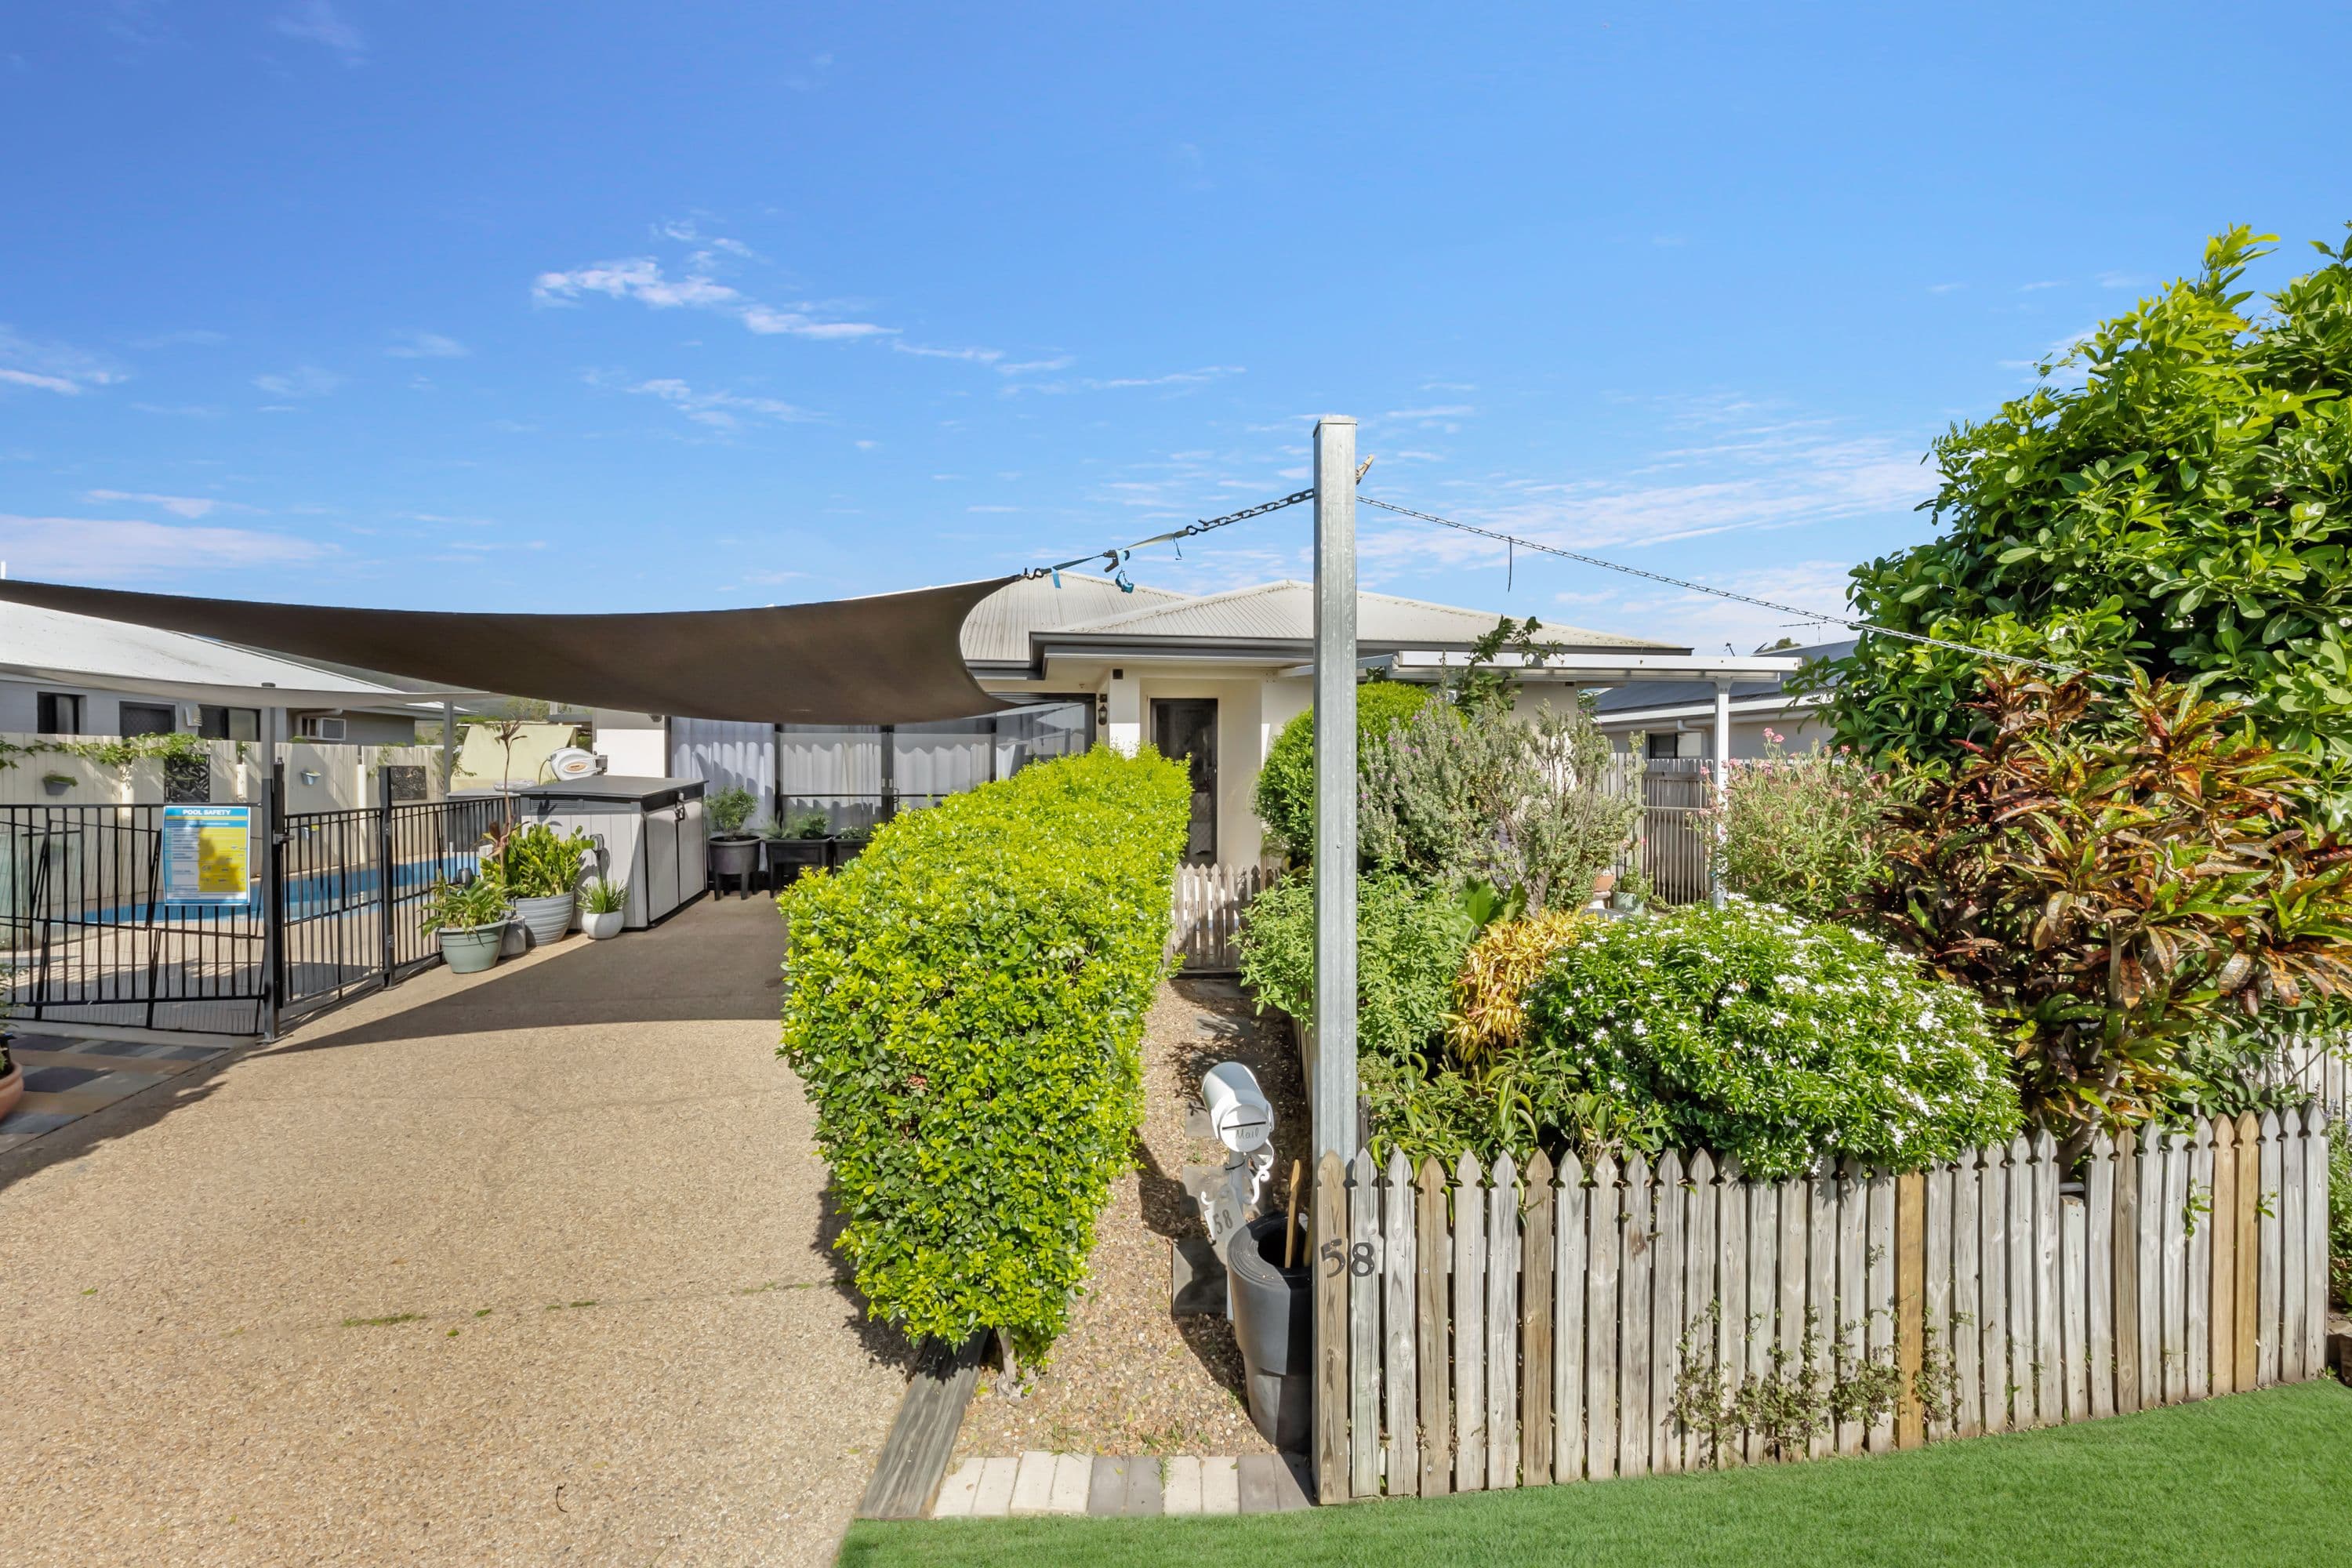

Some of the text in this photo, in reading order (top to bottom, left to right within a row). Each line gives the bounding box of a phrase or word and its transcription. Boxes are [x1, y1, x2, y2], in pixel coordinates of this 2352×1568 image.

[1235, 1127, 1259, 1139] Mail
[1213, 1209, 1233, 1235] 58
[1320, 1238, 1375, 1278] 58
